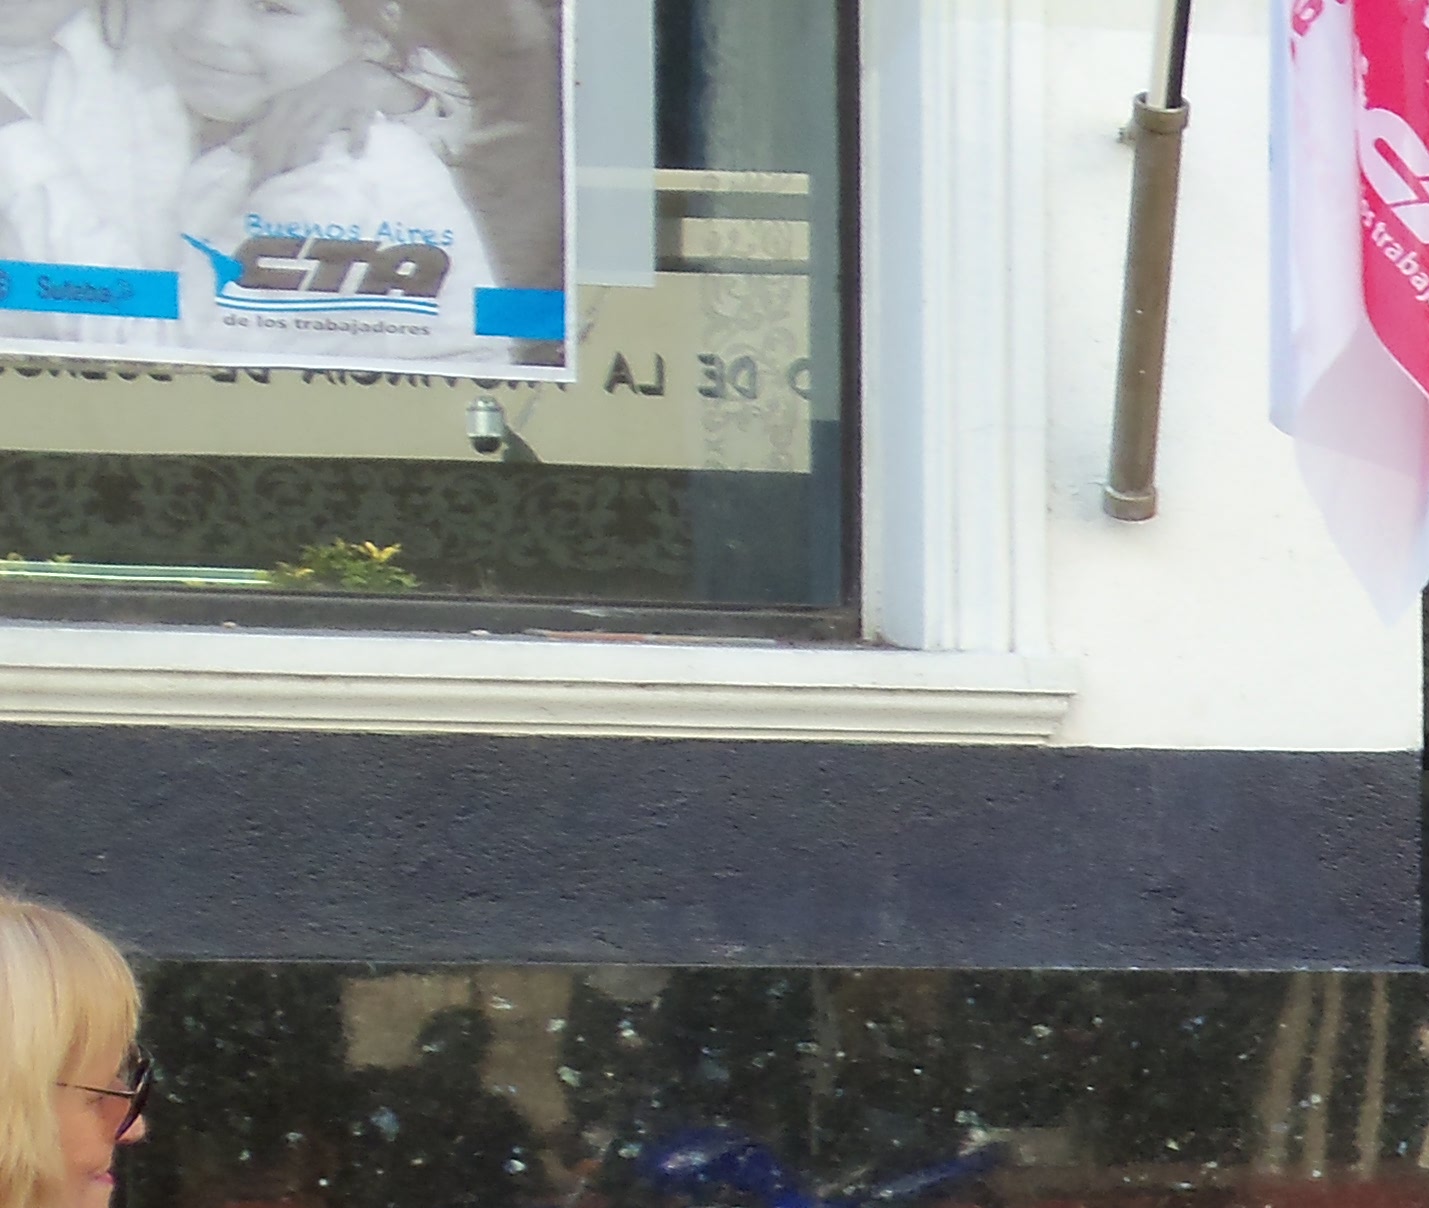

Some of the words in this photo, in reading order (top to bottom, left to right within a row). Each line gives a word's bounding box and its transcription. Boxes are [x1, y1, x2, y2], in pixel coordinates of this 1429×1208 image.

[245, 213, 360, 241] Buenos
[378, 220, 454, 246] Aires
[234, 238, 452, 299] CTA
[223, 312, 250, 328] de
[257, 313, 287, 330] los
[294, 316, 431, 337] trabajadores
